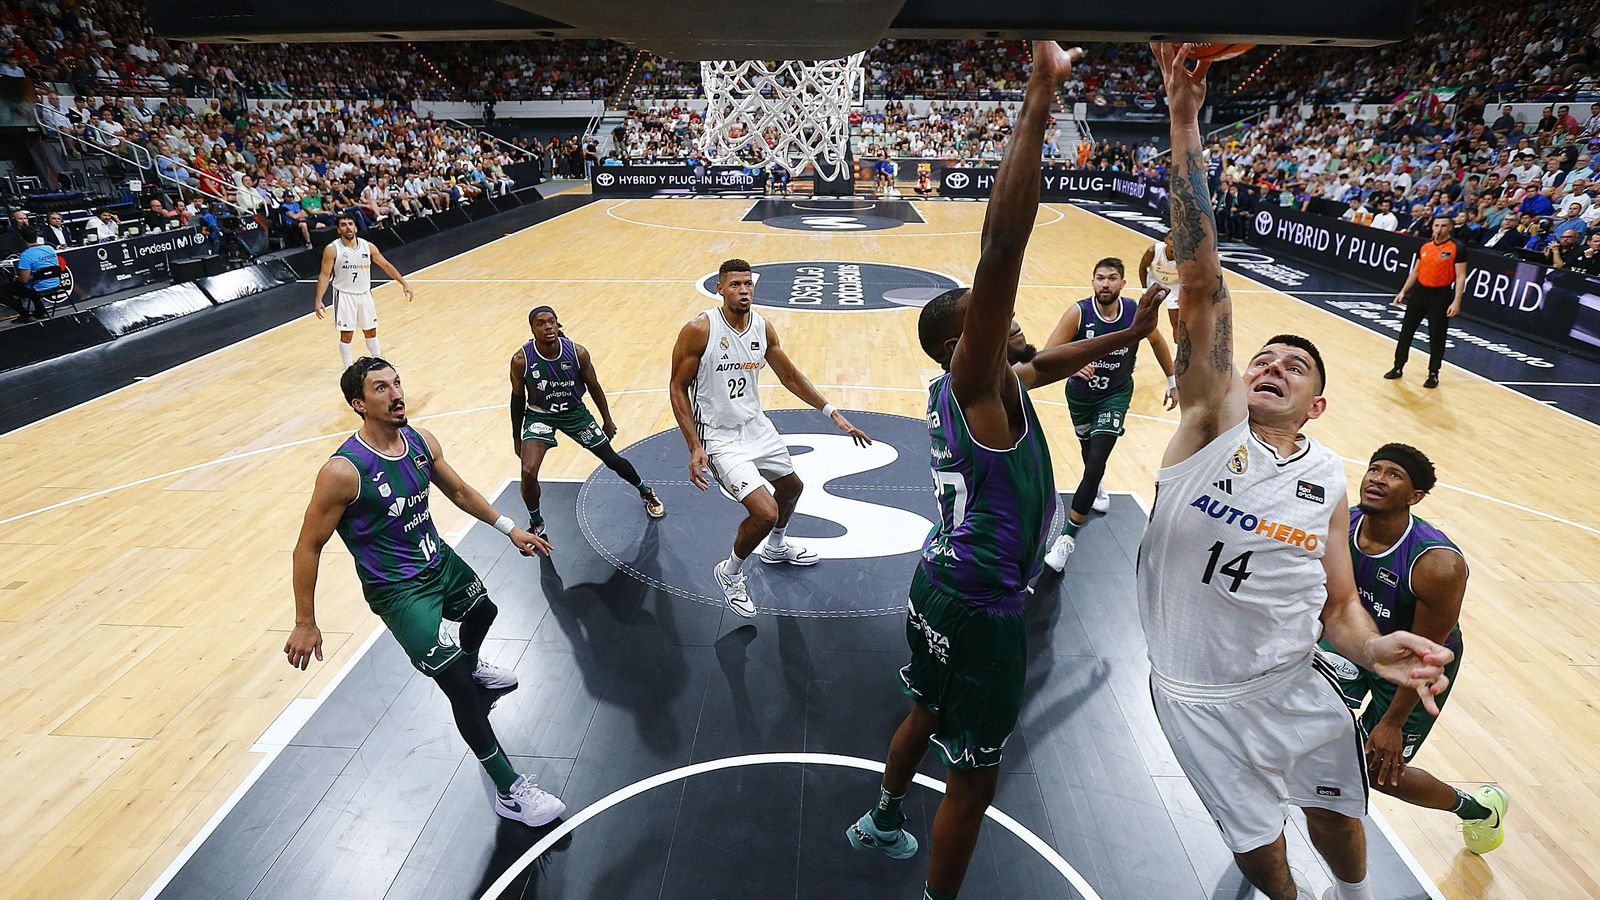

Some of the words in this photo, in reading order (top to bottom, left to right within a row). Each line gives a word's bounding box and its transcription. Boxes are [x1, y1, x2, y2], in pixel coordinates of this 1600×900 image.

[619, 175, 657, 185] HYBRID
[659, 175, 666, 185] Y
[668, 175, 712, 185] PLUG-IN
[715, 175, 754, 185] HYBRID
[1044, 176, 1055, 189] Y
[1059, 176, 1122, 192] PLUG-IN
[1122, 179, 1147, 198] HYBRID
[140, 242, 172, 256] endesa
[1277, 218, 1331, 252] HYBRID
[1335, 233, 1348, 257] Y
[1348, 235, 1418, 276] PLUG-I
[1452, 267, 1543, 312] YBRID
[352, 272, 358, 283] 7
[788, 266, 834, 305] endesa
[831, 264, 865, 306] supercopa
[715, 361, 760, 372] AUTOHERO
[727, 377, 747, 400] 22
[1088, 375, 1110, 390] 33
[1297, 491, 1324, 503] endesa
[1190, 494, 1318, 552] AUTOHERO
[418, 532, 437, 562] 14
[1201, 540, 1254, 593] 14
